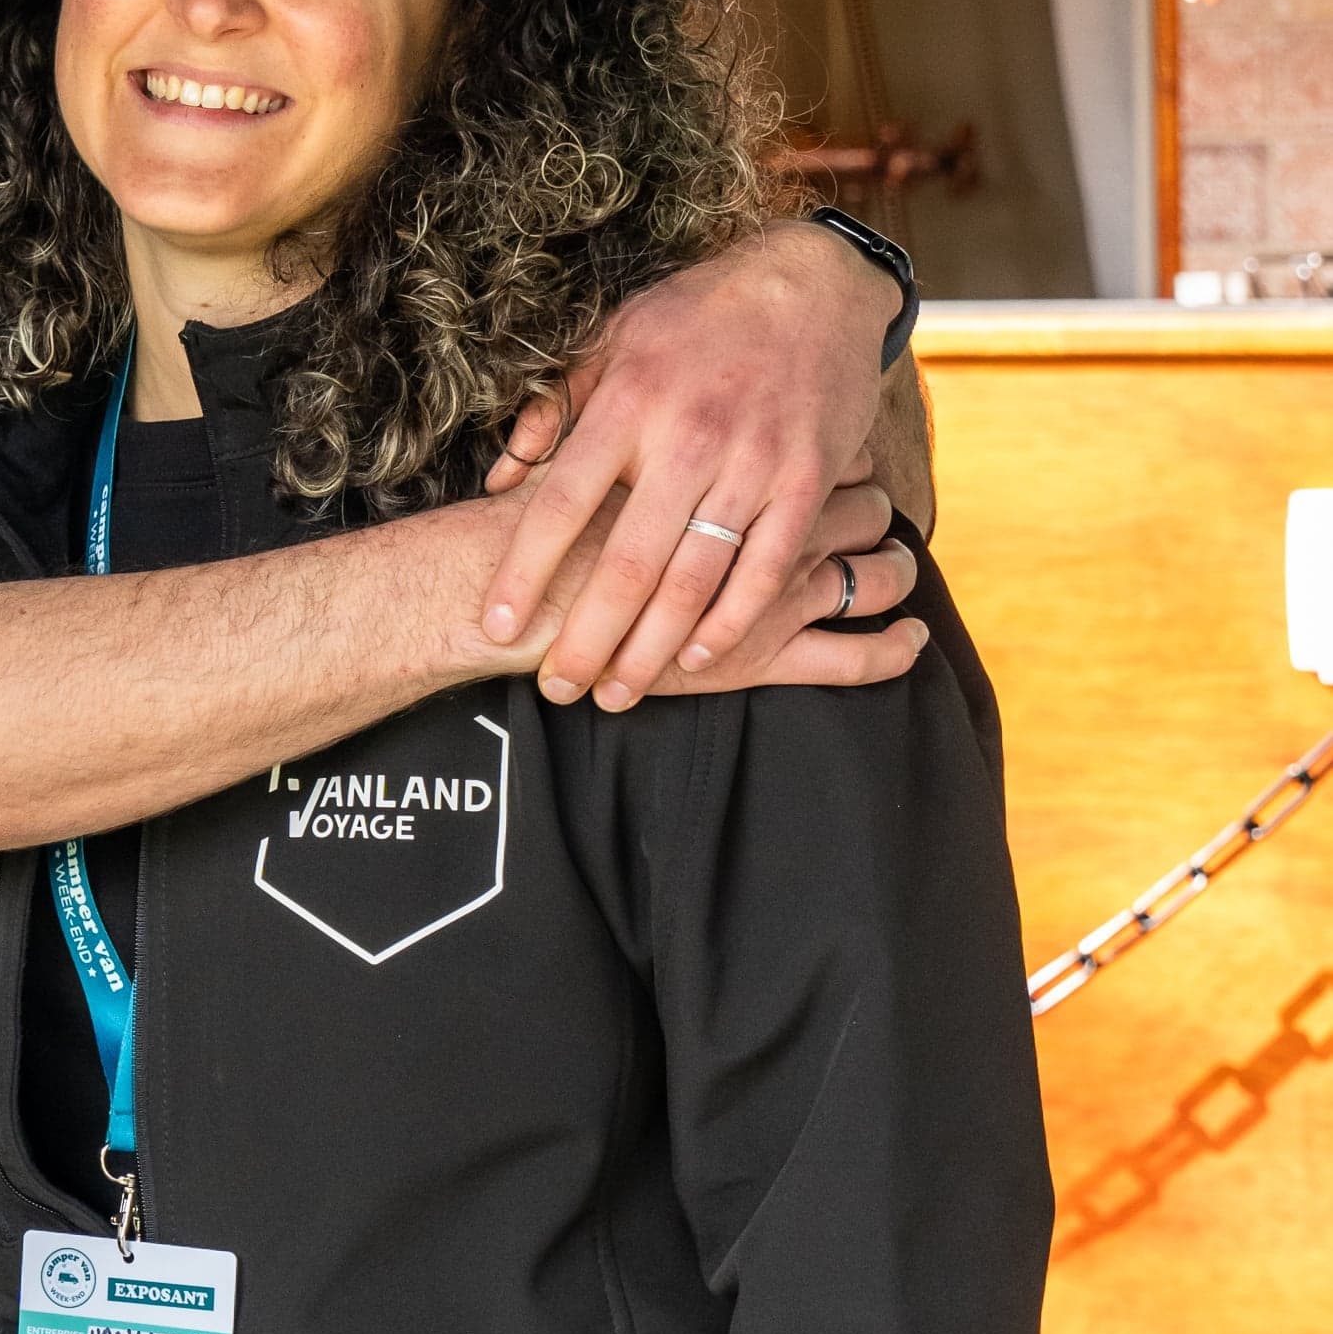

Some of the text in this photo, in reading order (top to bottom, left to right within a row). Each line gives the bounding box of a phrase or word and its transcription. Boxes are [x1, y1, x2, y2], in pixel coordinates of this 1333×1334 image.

[96, 484, 109, 576] campe
[55, 863, 93, 965] WEEK-END
[66, 840, 124, 993] amper van
[46, 1253, 91, 1282] camper van
[51, 1287, 85, 1303] WEEK-END
[114, 1281, 209, 1307] EXPOSANT
